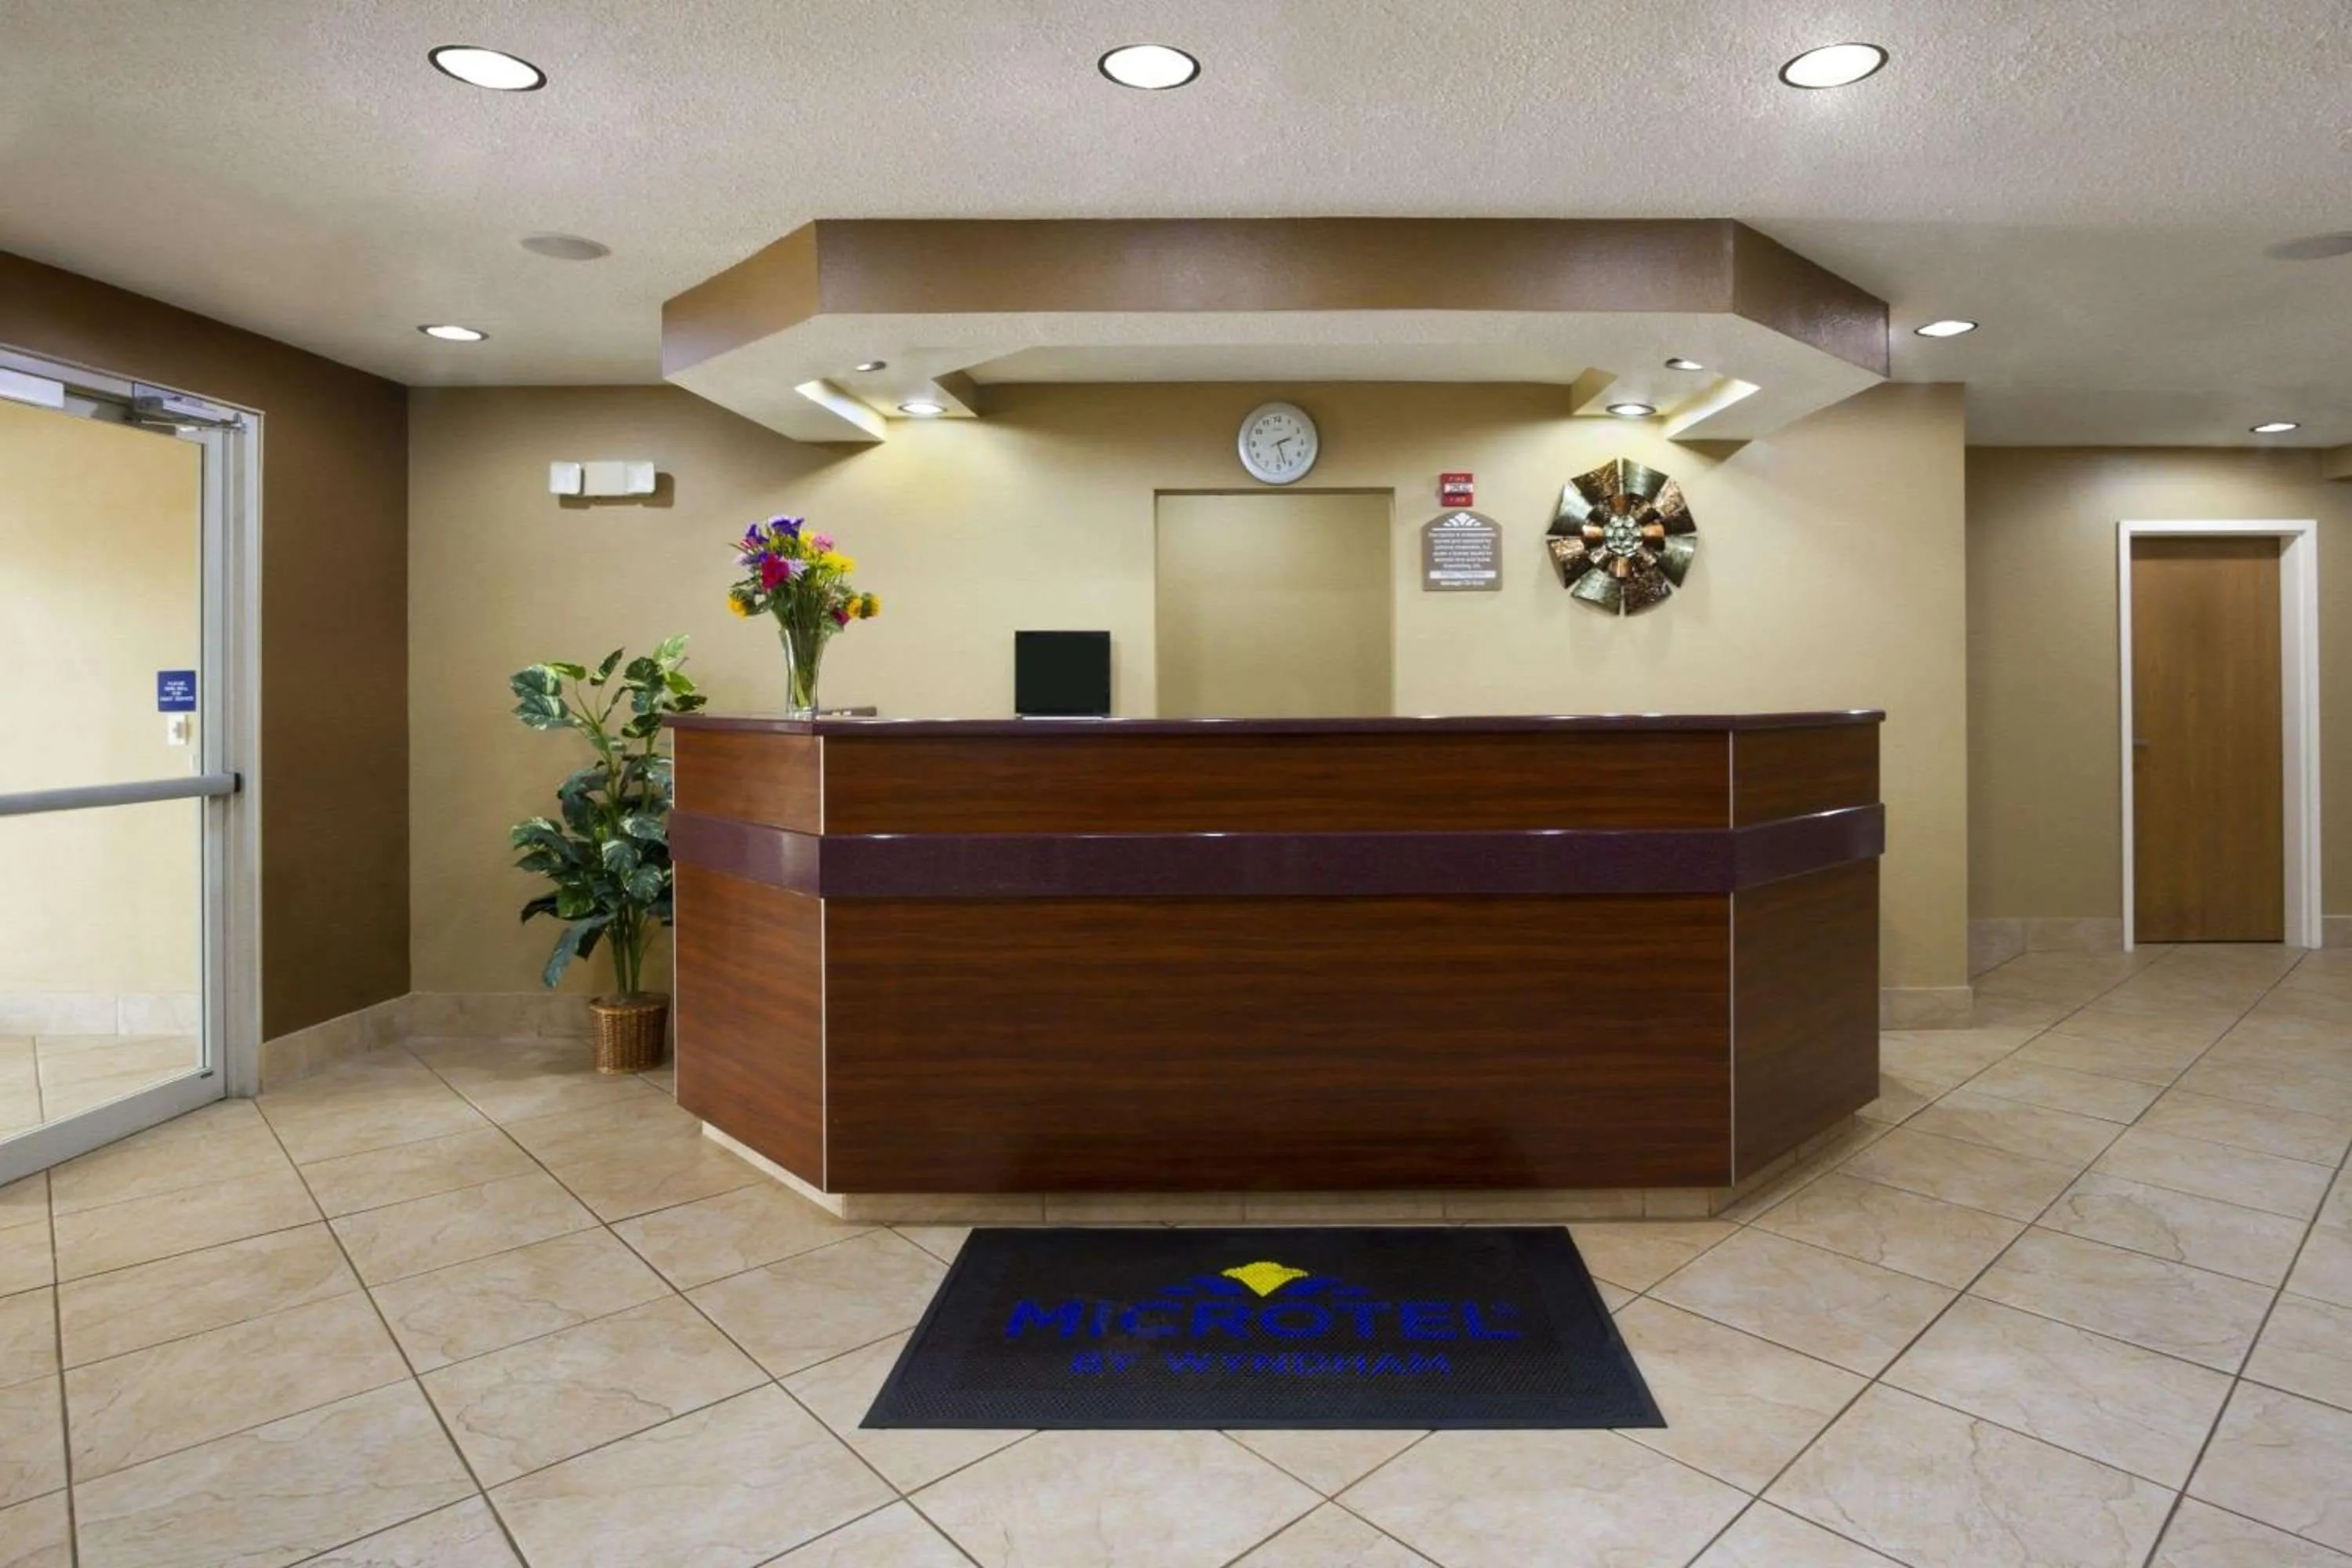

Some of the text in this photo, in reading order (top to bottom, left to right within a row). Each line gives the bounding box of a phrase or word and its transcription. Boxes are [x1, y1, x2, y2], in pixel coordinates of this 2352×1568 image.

[1004, 1298, 1525, 1340] MICROTEL
[1068, 1349, 1452, 1376] BY WYNDHAM
